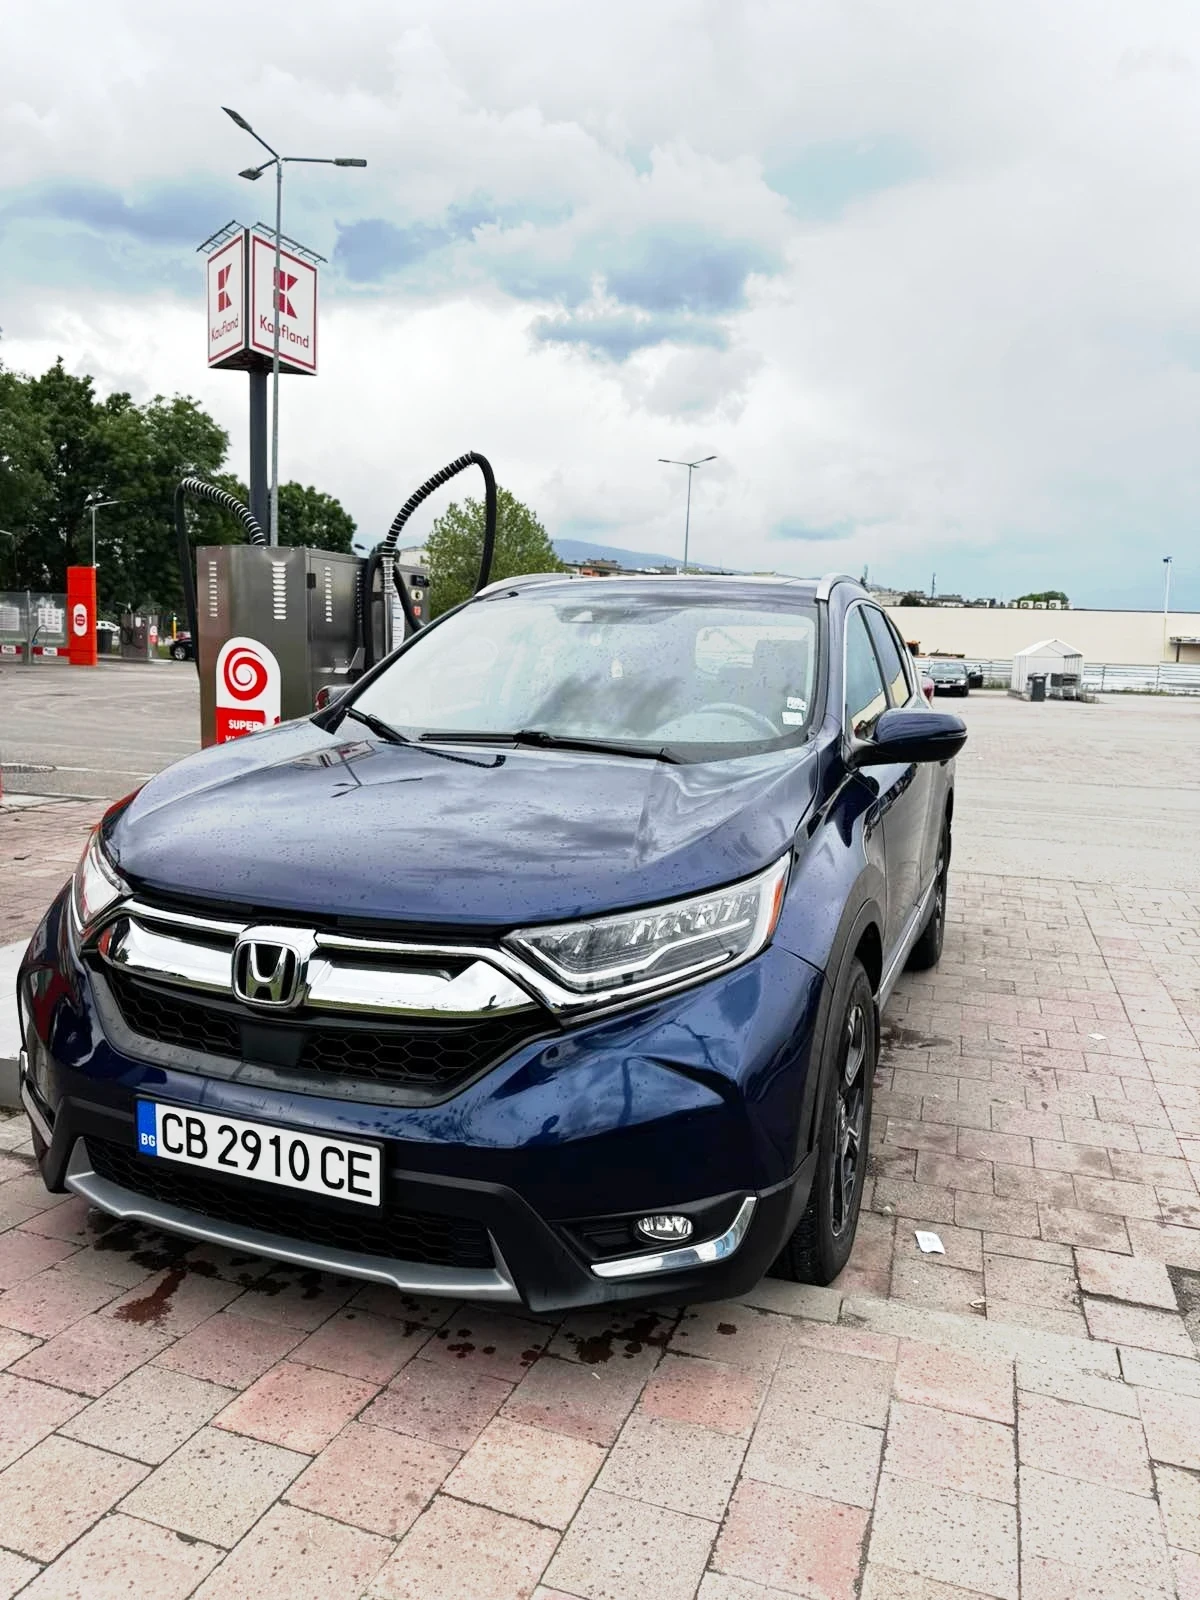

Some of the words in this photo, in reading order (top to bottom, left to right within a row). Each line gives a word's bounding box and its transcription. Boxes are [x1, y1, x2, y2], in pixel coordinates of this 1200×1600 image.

[211, 314, 239, 342] Kaufland
[260, 314, 309, 348] Kafland
[141, 1133, 156, 1147] BG
[162, 1113, 208, 1159] CB
[217, 1125, 310, 1182] 2910
[320, 1146, 373, 1198] CE
